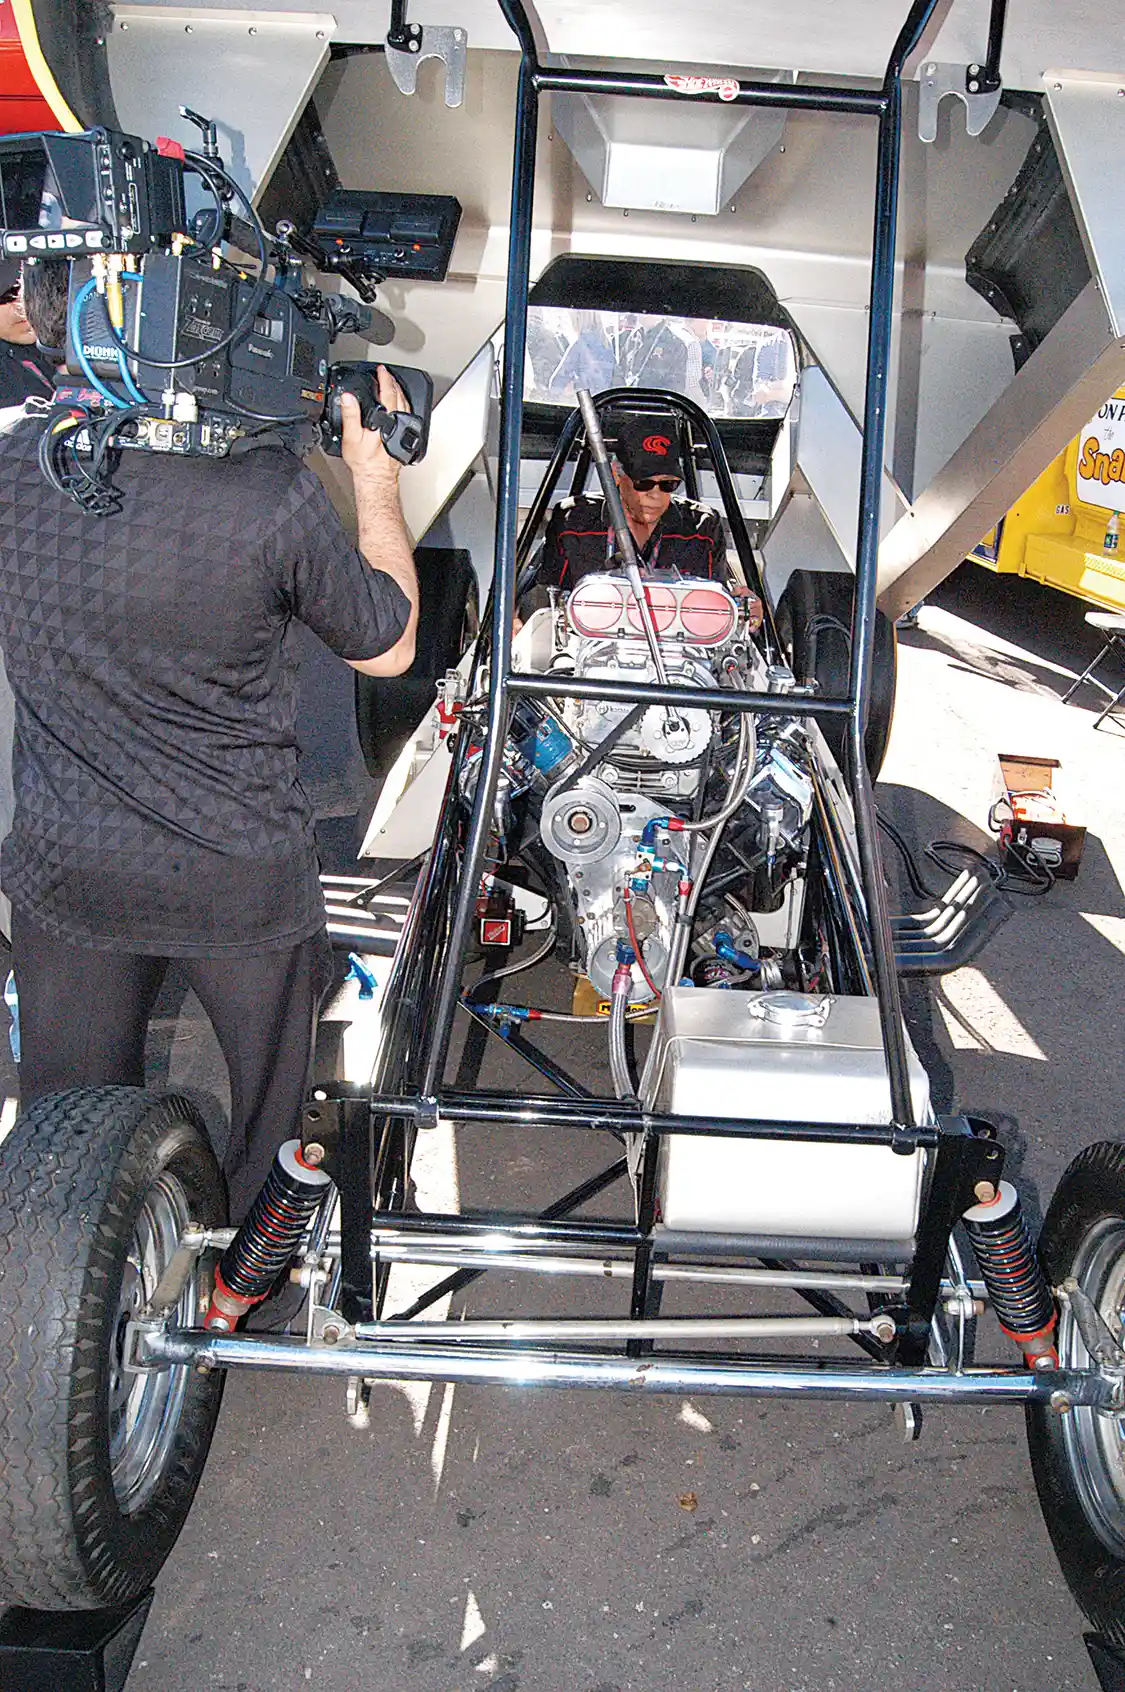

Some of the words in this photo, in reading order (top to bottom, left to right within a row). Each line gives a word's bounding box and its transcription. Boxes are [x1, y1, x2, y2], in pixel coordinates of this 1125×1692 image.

[1118, 405, 1125, 421] P
[1079, 436, 1125, 486] Sna
[1056, 504, 1070, 515] GAS
